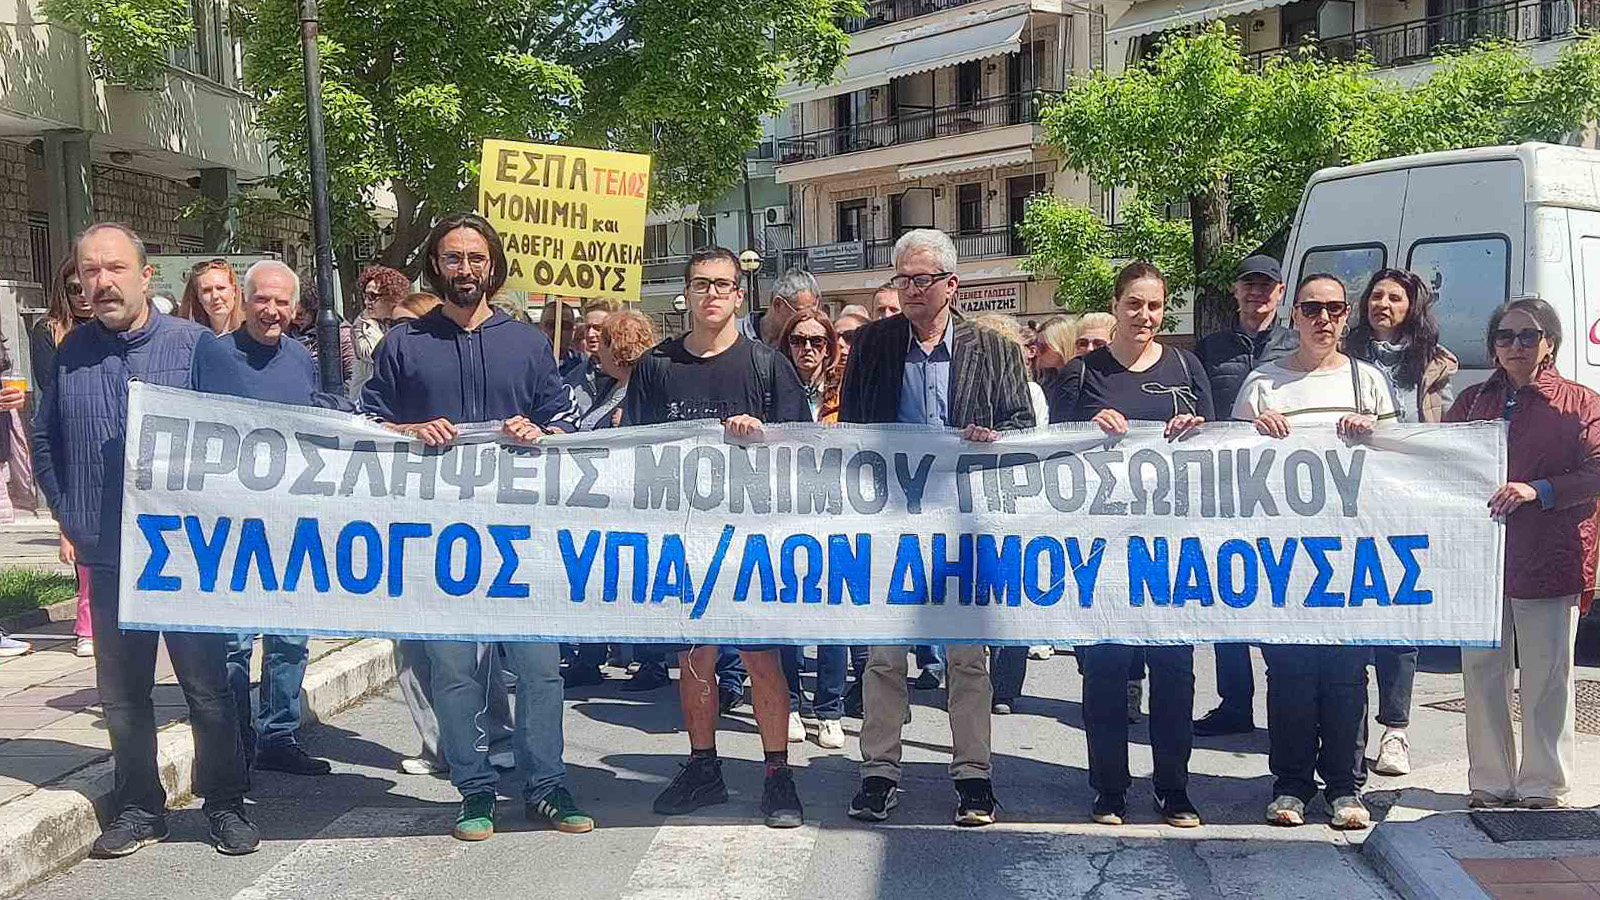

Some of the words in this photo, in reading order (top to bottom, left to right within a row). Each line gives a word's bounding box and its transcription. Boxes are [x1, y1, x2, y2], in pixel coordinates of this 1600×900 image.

[496, 148, 588, 191] ΕΣΠΑ
[593, 168, 647, 198] ΤΕΛΟΣ
[484, 191, 588, 229] ΜΟΝΙΜΗ
[592, 218, 619, 233] και
[498, 232, 564, 260] ΤΑΘΕΡΗ
[571, 240, 644, 265] ΔΟΥΛΕΙΑ
[534, 260, 626, 292] ΟΛΟΥΣ
[984, 287, 1017, 298] ΓΛΩΣΣΕΣ
[135, 414, 609, 509] ΠΡΟΣΛΗΨΕΙΣ
[633, 444, 936, 516] ΜΟΝΙΜΟΥ
[955, 448, 1366, 518] ΠΡΟΣΩΠΙΚΟΥ
[136, 513, 532, 599] ΣΥΛΛΟΓΟΣ
[557, 524, 872, 620] ΥΠΑ/ΛΩΝ
[887, 533, 1107, 609] ΔΗΜΟΥ
[1127, 533, 1434, 609] ΝΑΟΥΣΑΣ
